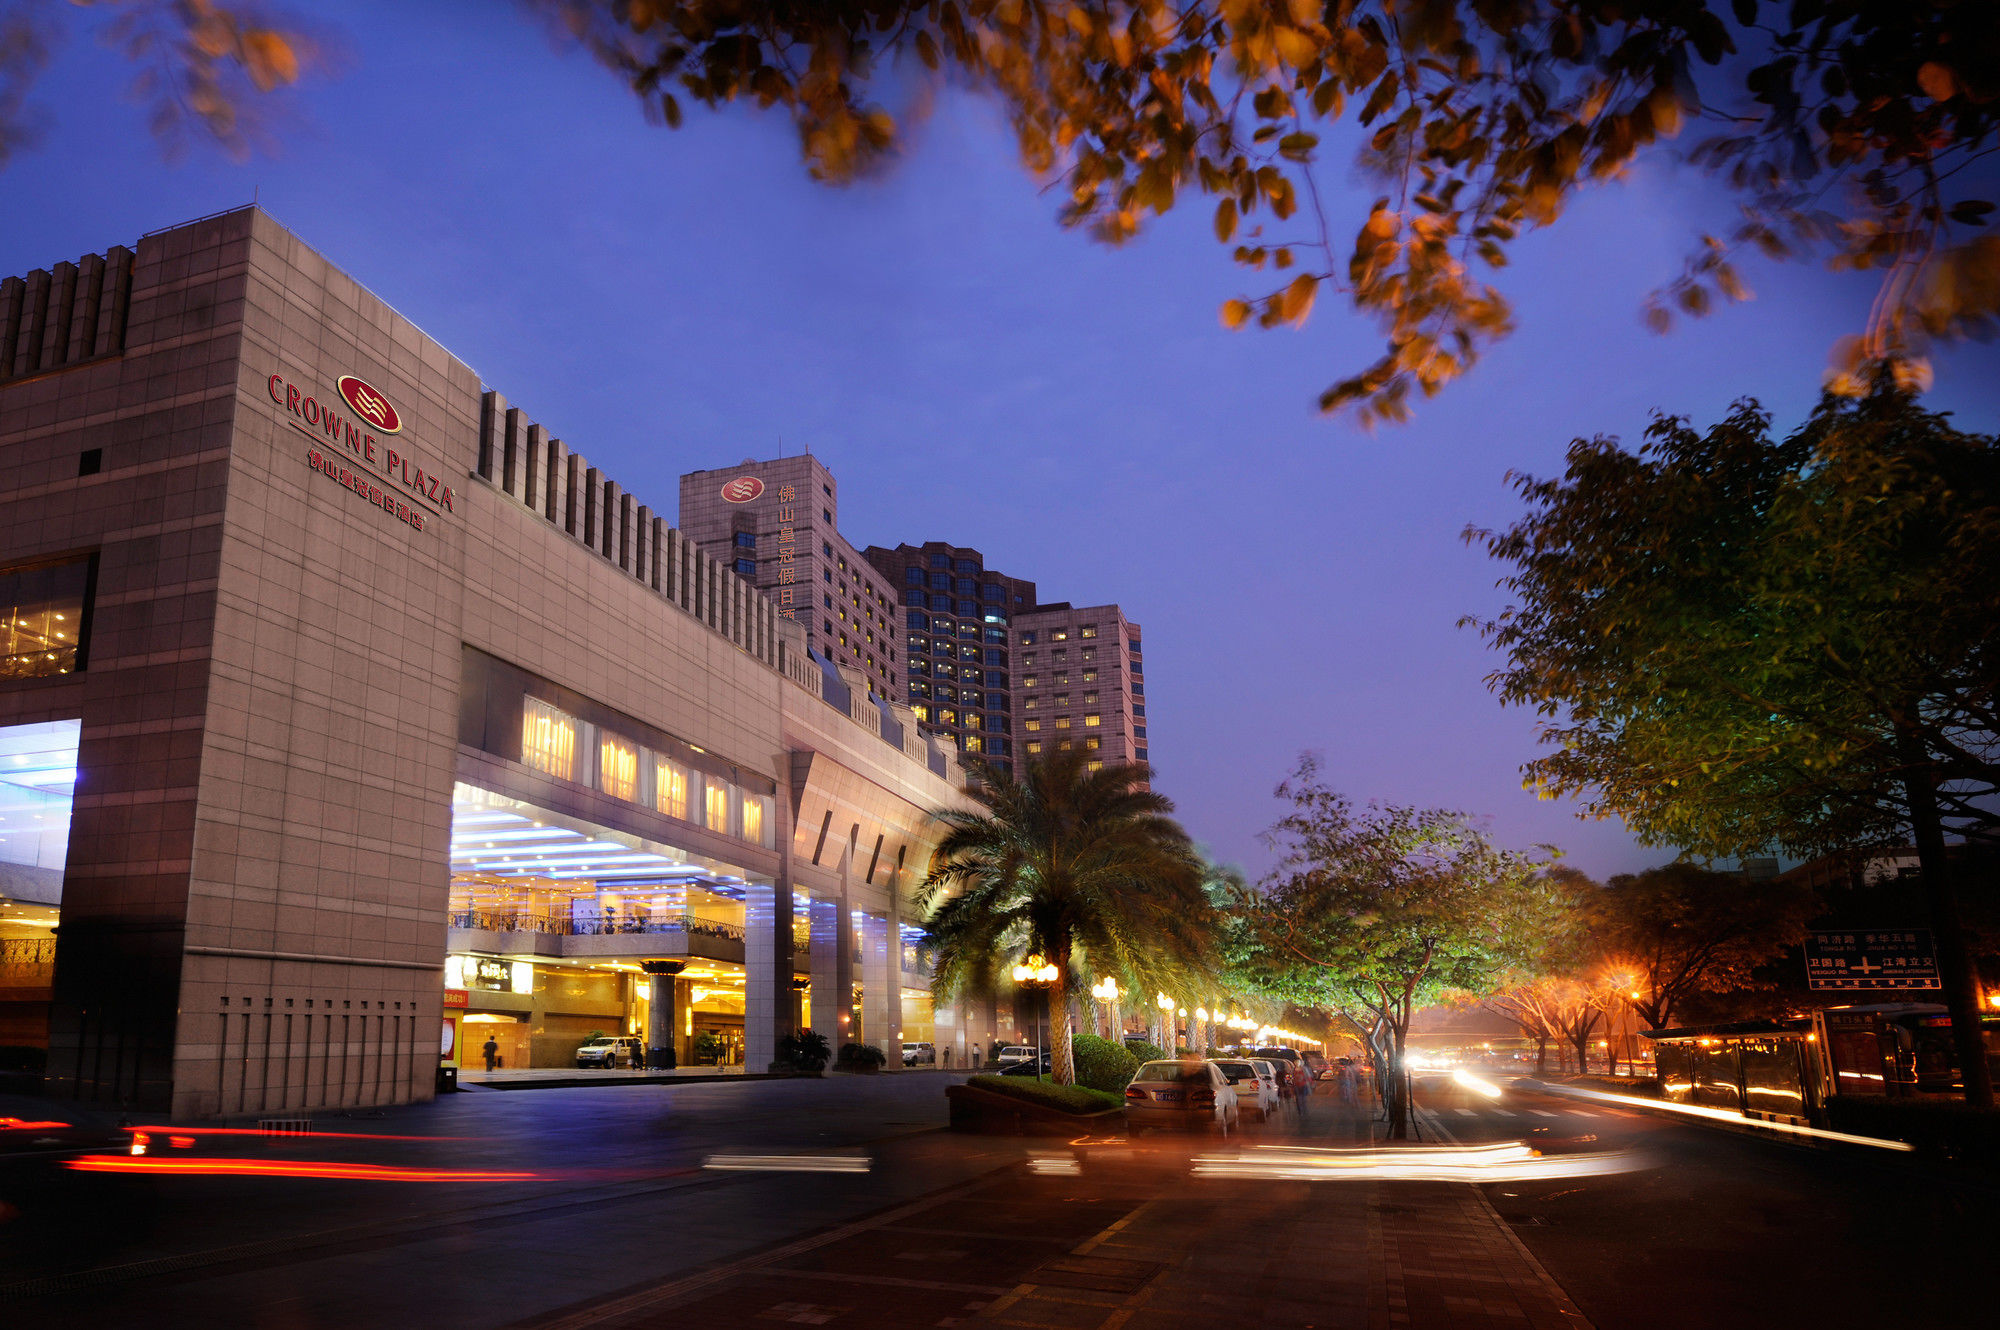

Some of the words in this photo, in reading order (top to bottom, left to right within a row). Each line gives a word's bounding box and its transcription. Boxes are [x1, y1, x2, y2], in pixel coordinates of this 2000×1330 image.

[269, 374, 376, 463] CROWNE
[388, 448, 454, 512] PLAZA
[308, 448, 424, 531] 佛山皇冠假日酒店
[1809, 958, 1846, 967] 卫国路
[1882, 957, 1933, 967] 江湾立交
